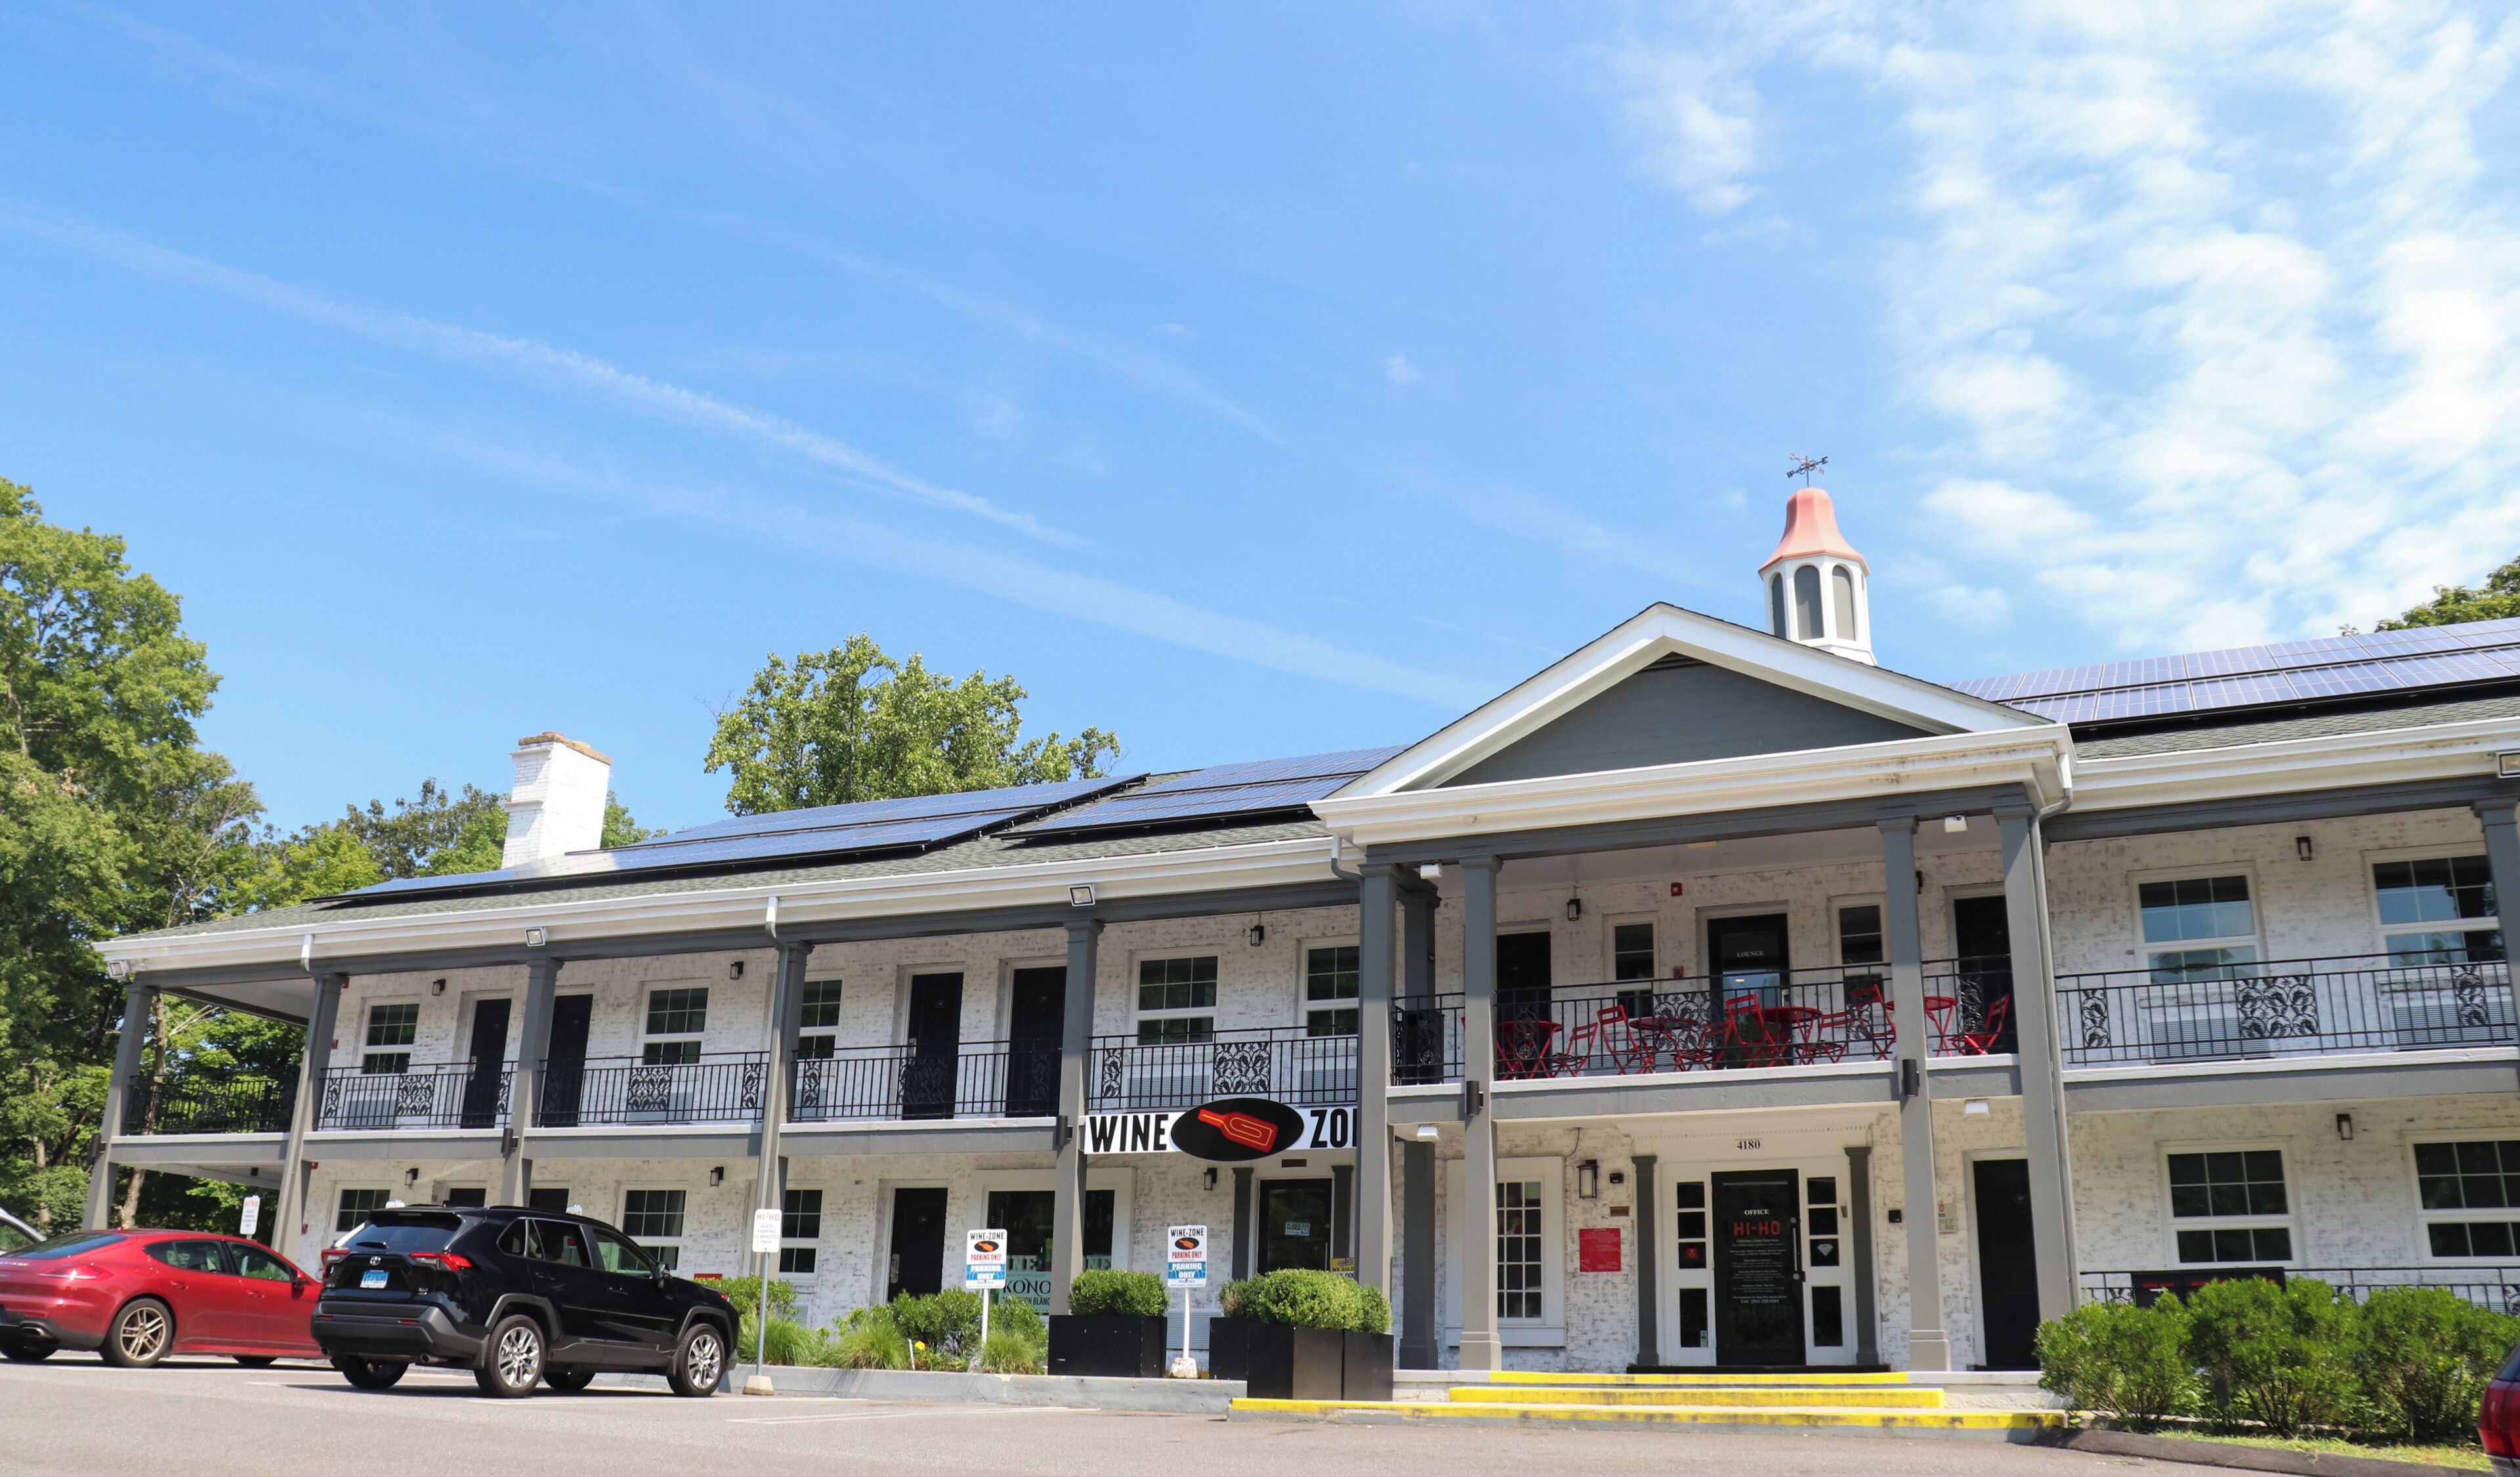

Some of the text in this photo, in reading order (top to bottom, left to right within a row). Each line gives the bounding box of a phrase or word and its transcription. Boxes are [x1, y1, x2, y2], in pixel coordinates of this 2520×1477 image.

[1089, 1108, 1357, 1153] WINE ZO
[1736, 1140, 1761, 1149] 4180
[1734, 1221, 1780, 1235] HI-HO
[1003, 1277, 1051, 1296] KONO
[1033, 1296, 1050, 1305] BLANC
